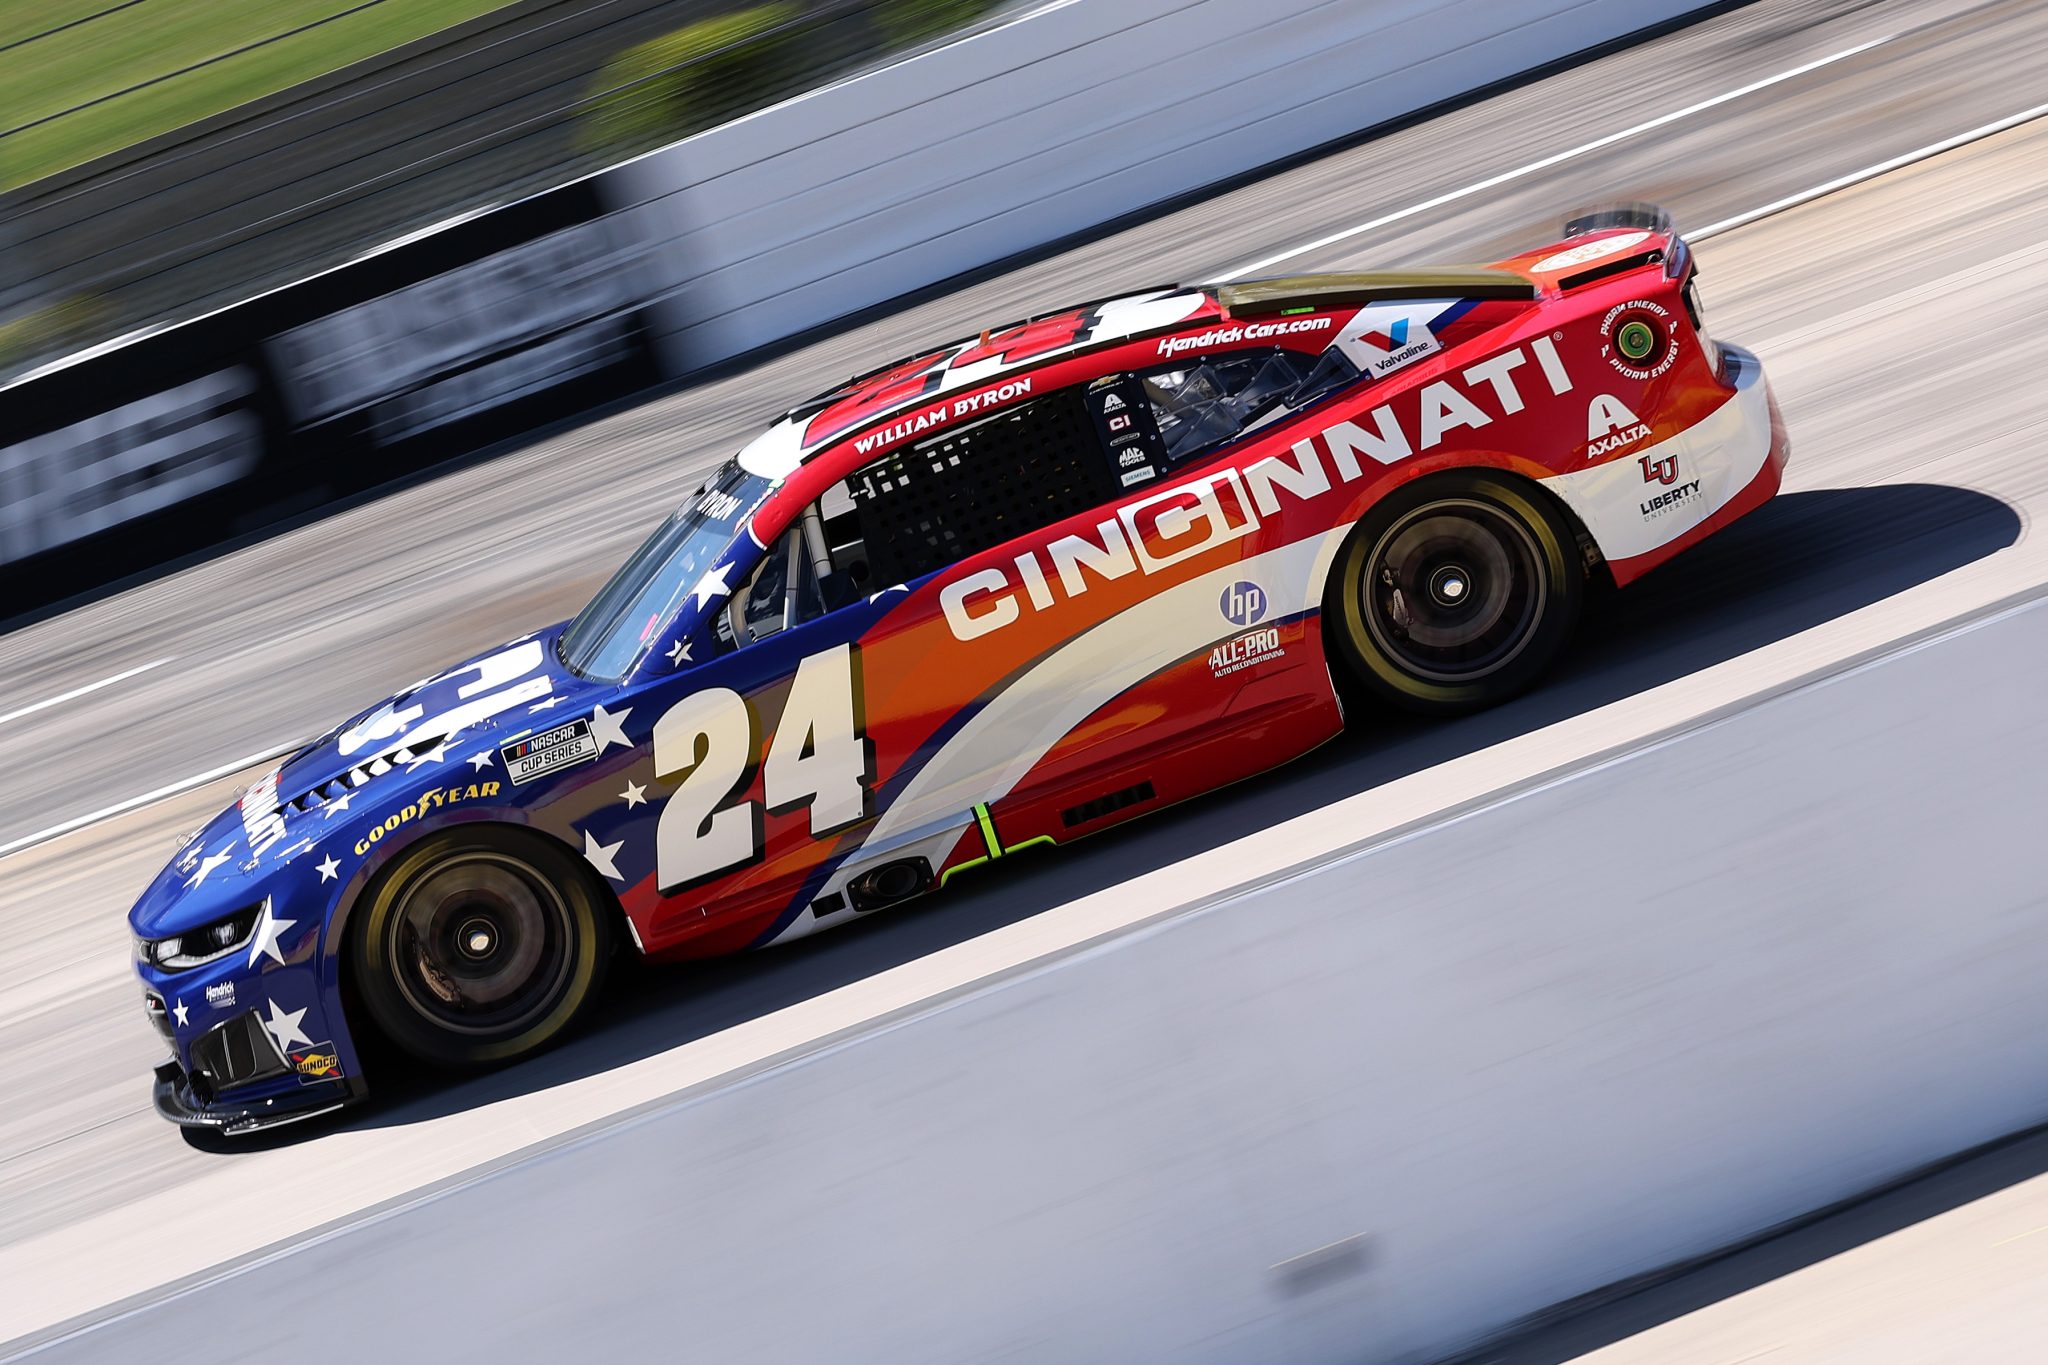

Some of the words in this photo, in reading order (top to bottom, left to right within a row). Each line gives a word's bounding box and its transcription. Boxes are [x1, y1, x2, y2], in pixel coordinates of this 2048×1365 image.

[1600, 303, 1626, 336] PHORM
[1627, 300, 1669, 317] ENERGY
[1157, 317, 1332, 357] HendrickCars.com
[1375, 341, 1429, 371] Valvoline
[1609, 358, 1649, 379] PHORM
[1651, 339, 1679, 378] ENERGY
[854, 407, 947, 455] WILLIAM
[953, 377, 1032, 420] BYRON
[1102, 402, 1126, 414] AXALTA
[1109, 414, 1131, 431] CI
[1119, 447, 1144, 465] MAC
[1587, 423, 1652, 459] AXALTA
[1120, 456, 1145, 468] TOOLS
[1125, 469, 1151, 482] SIEMENS
[1638, 454, 1679, 485] LU
[939, 334, 1573, 642] CINCINNATI
[1640, 479, 1701, 516] LIBERTY
[697, 489, 743, 521] BYRON
[1643, 492, 1703, 522] UNIVERSITY
[1229, 581, 1260, 627] hp
[1208, 628, 1279, 670] ALL-PRO
[1214, 666, 1232, 679] AUTO
[1232, 648, 1285, 671] RECONDITIONING
[531, 726, 576, 752] NASCAR
[521, 757, 543, 773] CUP
[545, 742, 582, 765] SERIES
[652, 641, 867, 893] 24
[354, 781, 500, 856] GOODYEAR
[206, 981, 234, 1002] Hendrick
[297, 1055, 337, 1073] SUNOCO
